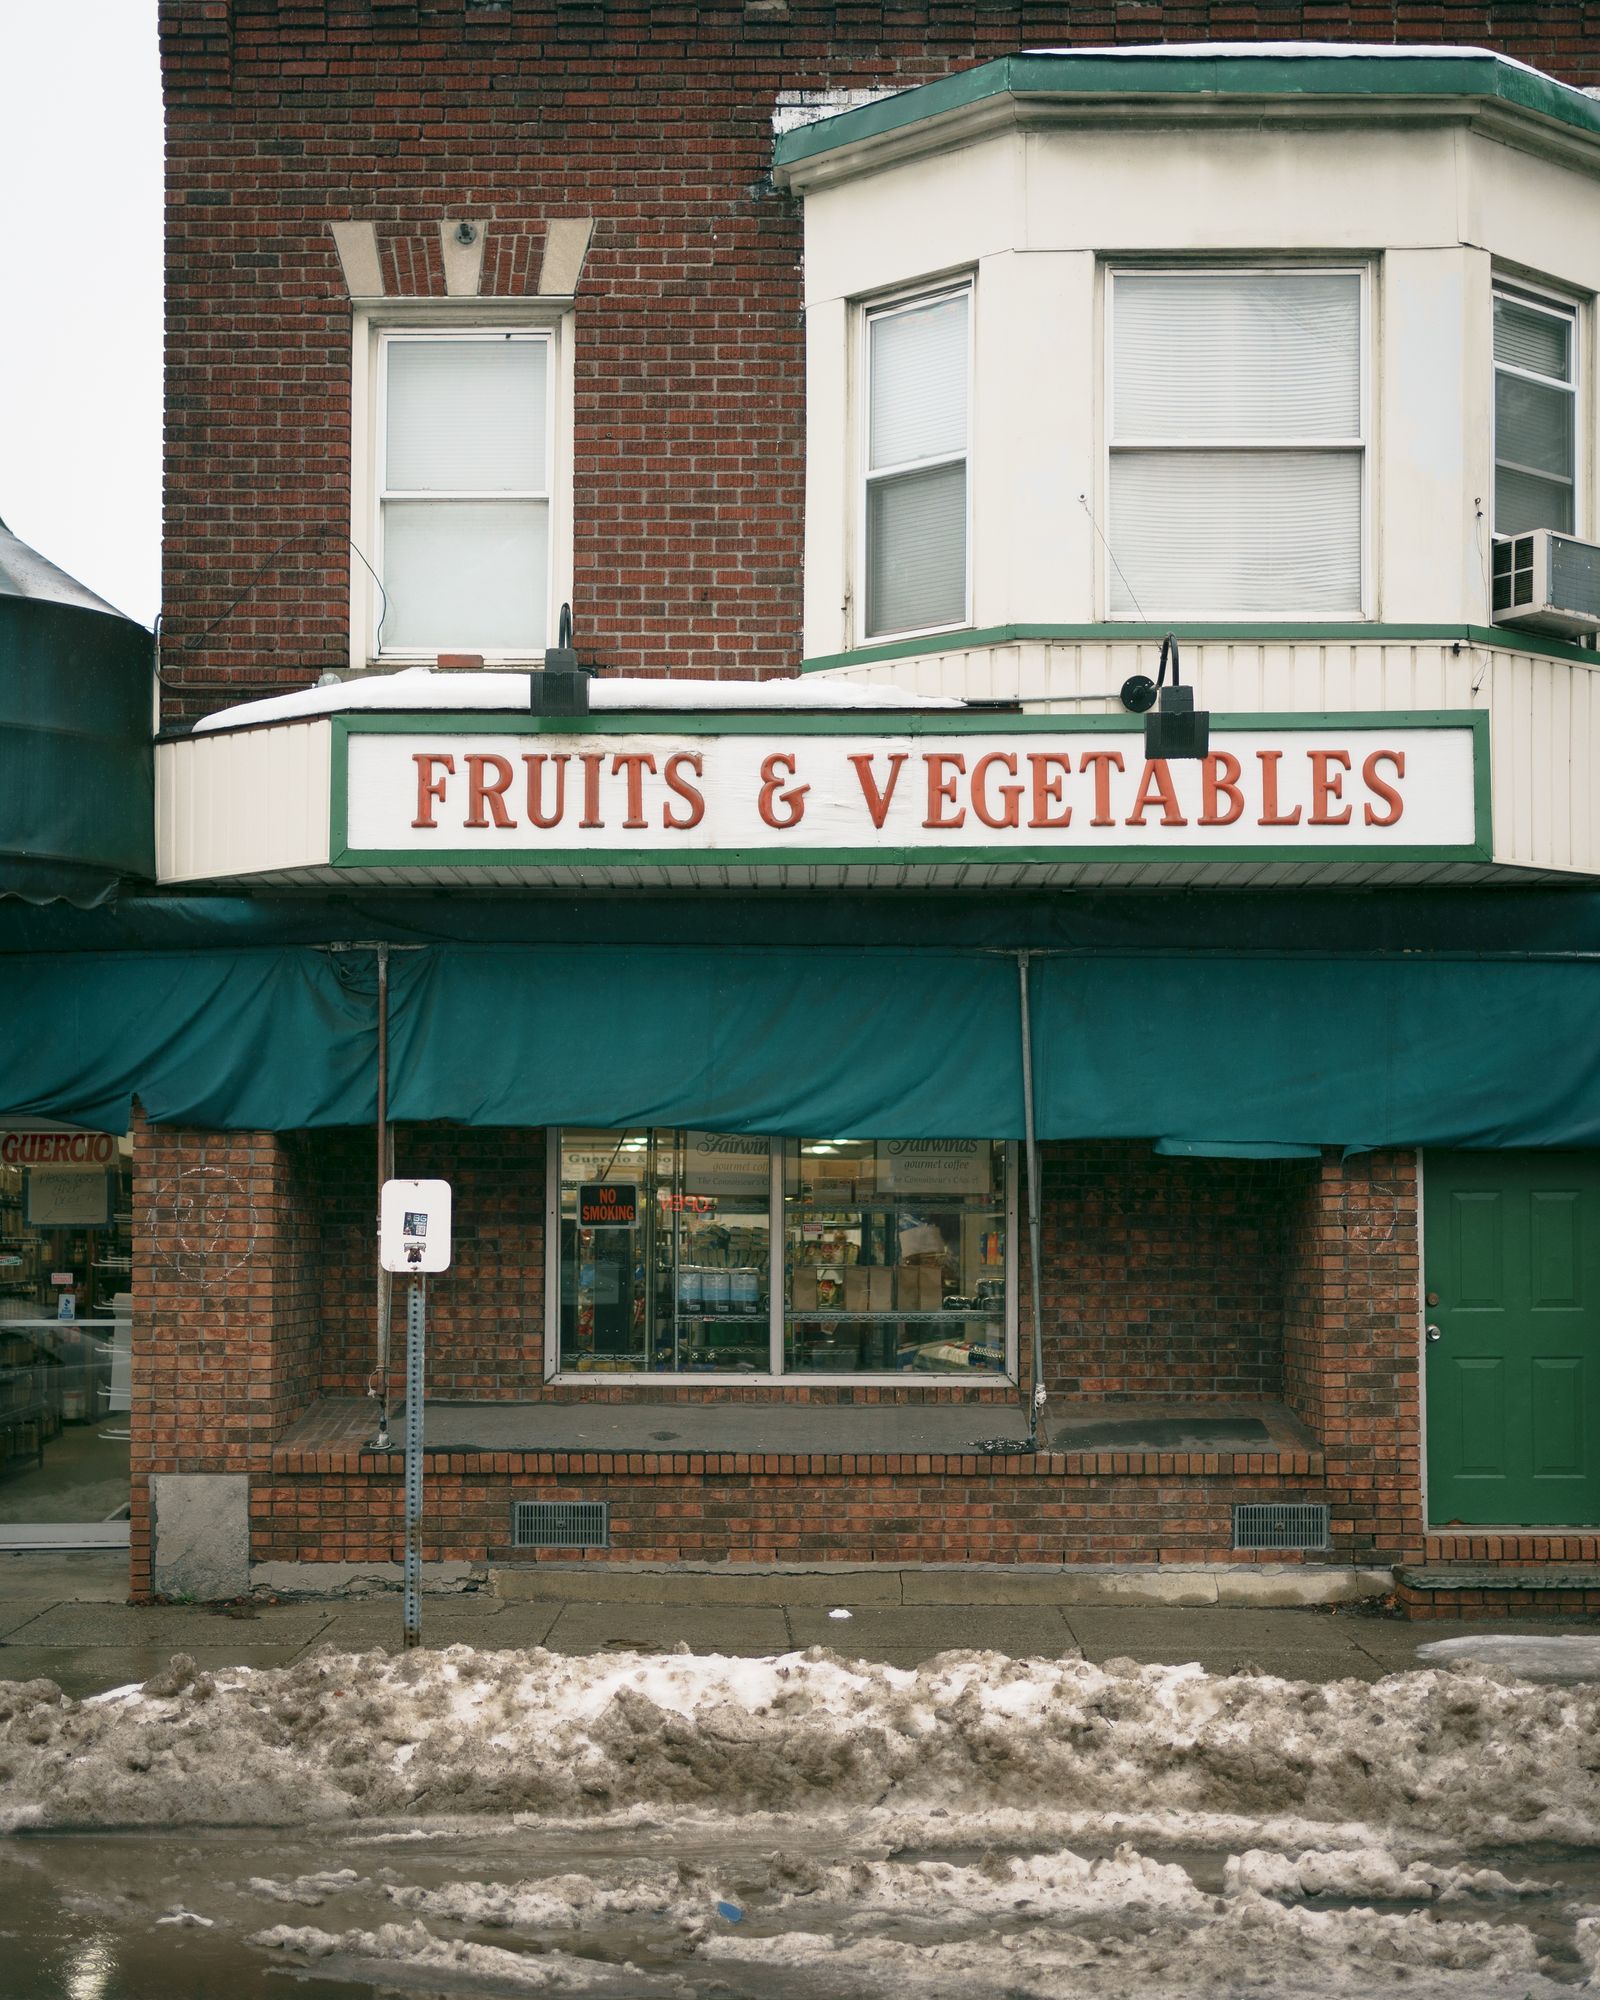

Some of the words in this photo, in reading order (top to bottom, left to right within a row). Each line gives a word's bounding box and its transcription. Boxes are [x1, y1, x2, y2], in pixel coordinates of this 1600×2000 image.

[411, 752, 705, 830] FRUITS
[757, 752, 811, 831] &
[847, 750, 1406, 829] VEGETABLES
[1, 1133, 114, 1163] GUERCIO
[568, 1153, 632, 1164] Guercio
[712, 1159, 752, 1173] gourmet
[904, 1159, 941, 1171] gourmet
[943, 1159, 969, 1171] coffee
[599, 1188, 616, 1203] NO
[582, 1205, 635, 1222] SMOKING
